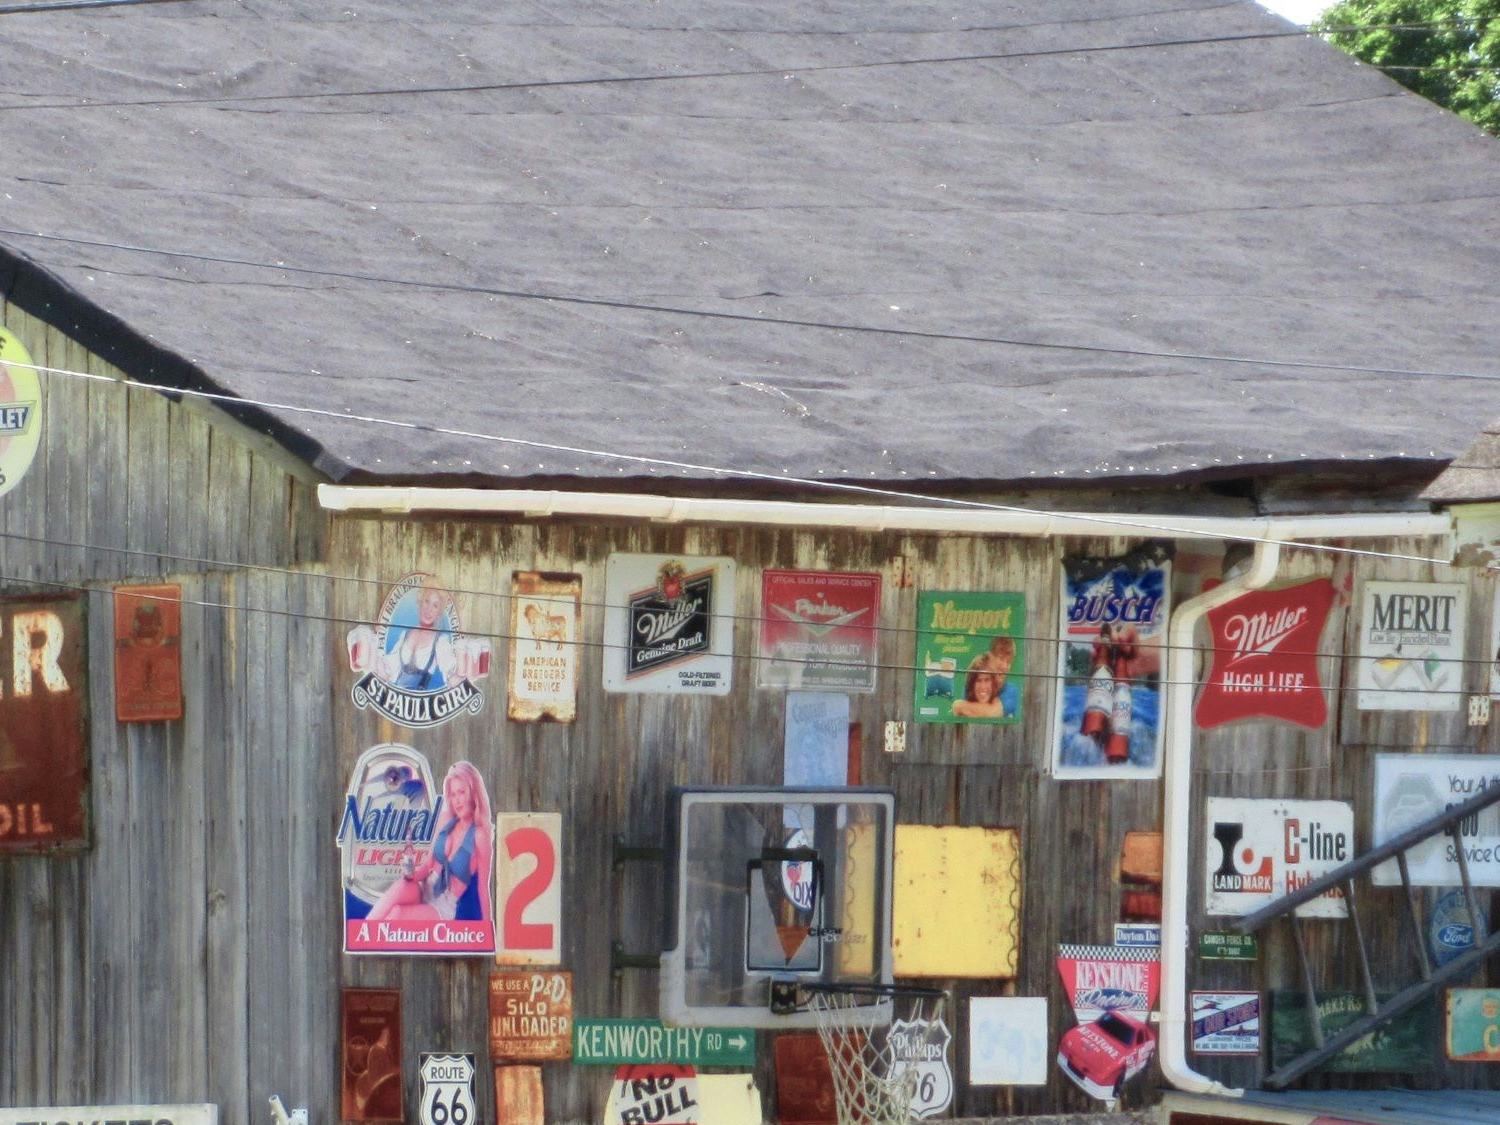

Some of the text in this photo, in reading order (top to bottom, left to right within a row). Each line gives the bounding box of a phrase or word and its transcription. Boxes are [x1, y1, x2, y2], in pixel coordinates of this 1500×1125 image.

[637, 597, 703, 646] Miller
[931, 600, 1011, 634] Newport
[1068, 593, 1159, 625] BUSCH
[1370, 593, 1456, 632] MERIT
[637, 632, 703, 663] Genuine Draft
[1224, 606, 1309, 667] Miller
[1223, 671, 1304, 692] HIGH LIFE
[385, 690, 433, 721] PAULI
[433, 681, 473, 718] GIRL
[1448, 775, 1474, 793] Your
[338, 794, 444, 844] Natural
[1284, 817, 1346, 864] C-line
[503, 827, 556, 951] 2
[1213, 873, 1272, 893] LANDMARK
[356, 922, 485, 943] A Natural Choice
[1116, 929, 1145, 943] Dayton
[1443, 926, 1471, 944] Ford
[492, 979, 505, 991] WE
[507, 978, 521, 991] USE
[521, 978, 530, 991] A
[1076, 961, 1144, 991] KEYSTONE
[506, 999, 548, 1015] SILO
[492, 1016, 568, 1037] UNLOADER
[577, 1025, 704, 1058] KENWORTHY
[707, 1033, 722, 1050] RD
[430, 1066, 464, 1080] ROUTE
